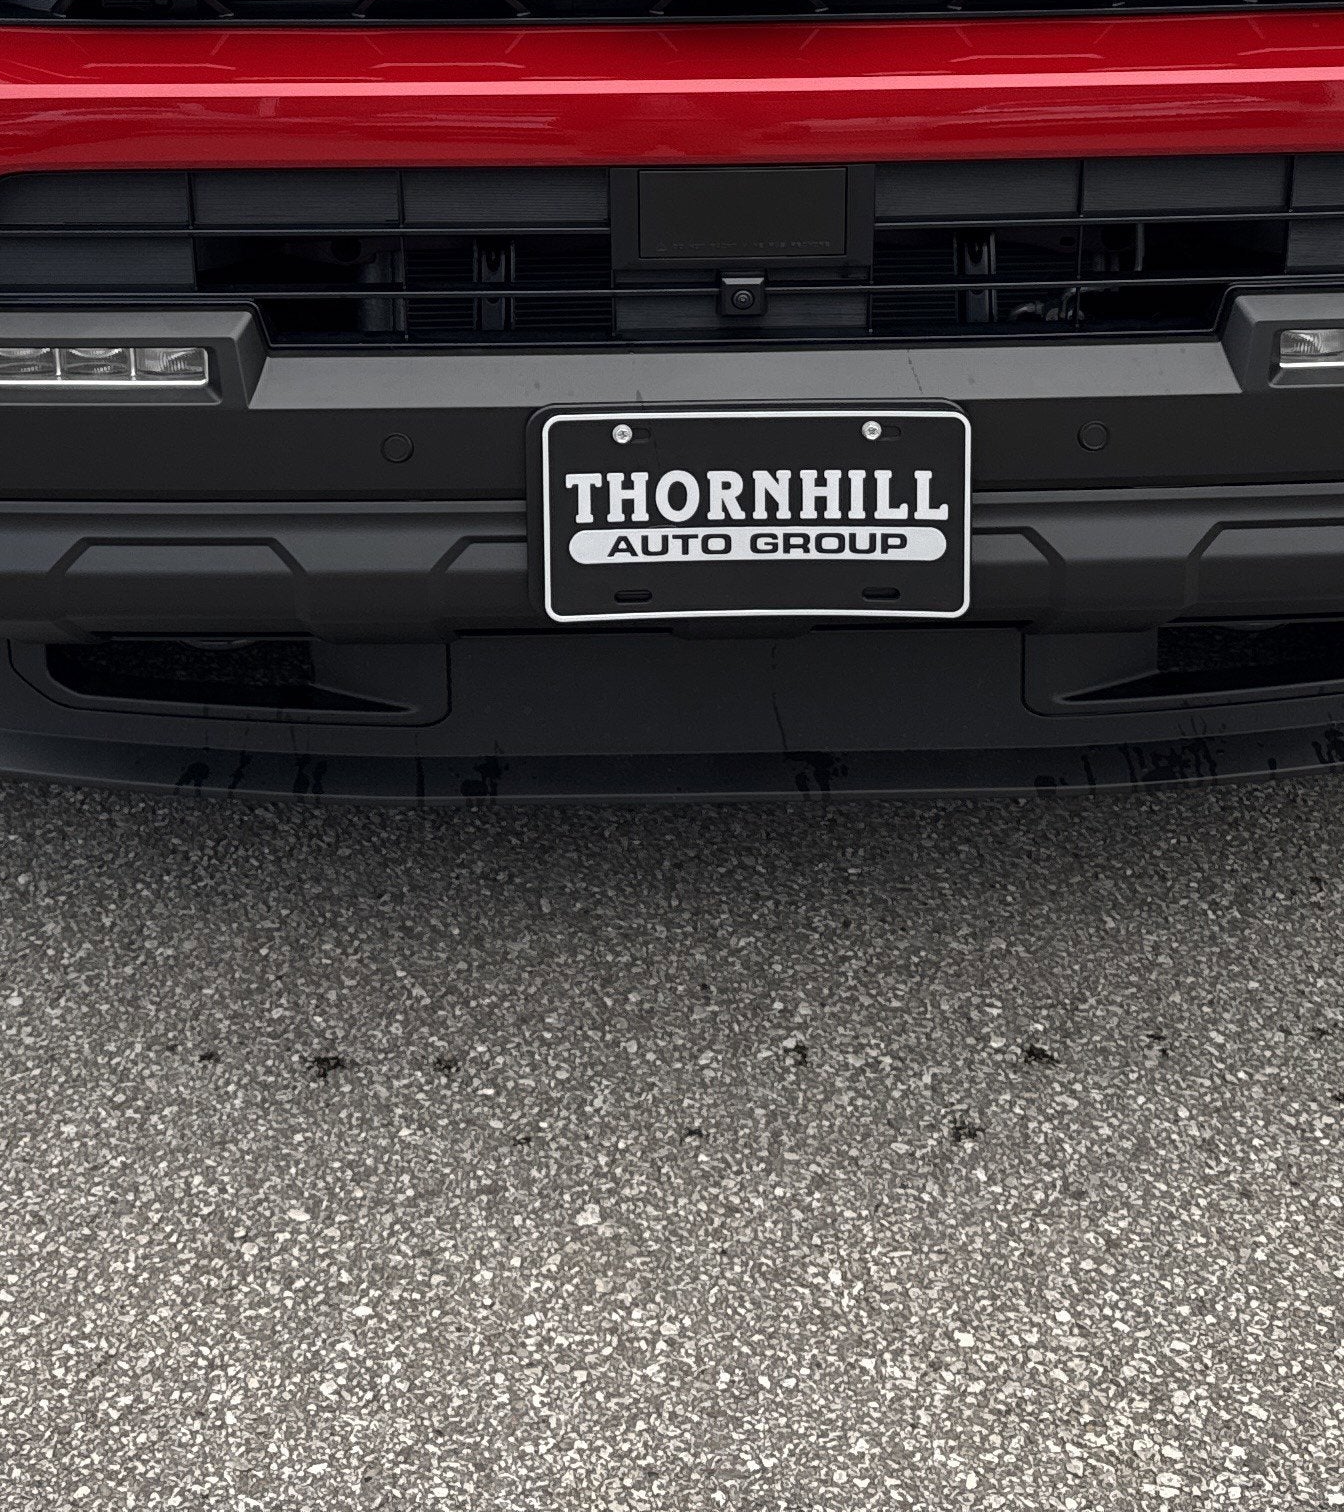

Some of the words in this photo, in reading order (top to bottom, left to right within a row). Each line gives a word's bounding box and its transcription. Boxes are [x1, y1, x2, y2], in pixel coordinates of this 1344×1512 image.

[565, 469, 949, 524] THORNHILL
[607, 533, 733, 557] AUTO
[749, 533, 908, 556] GROUP
